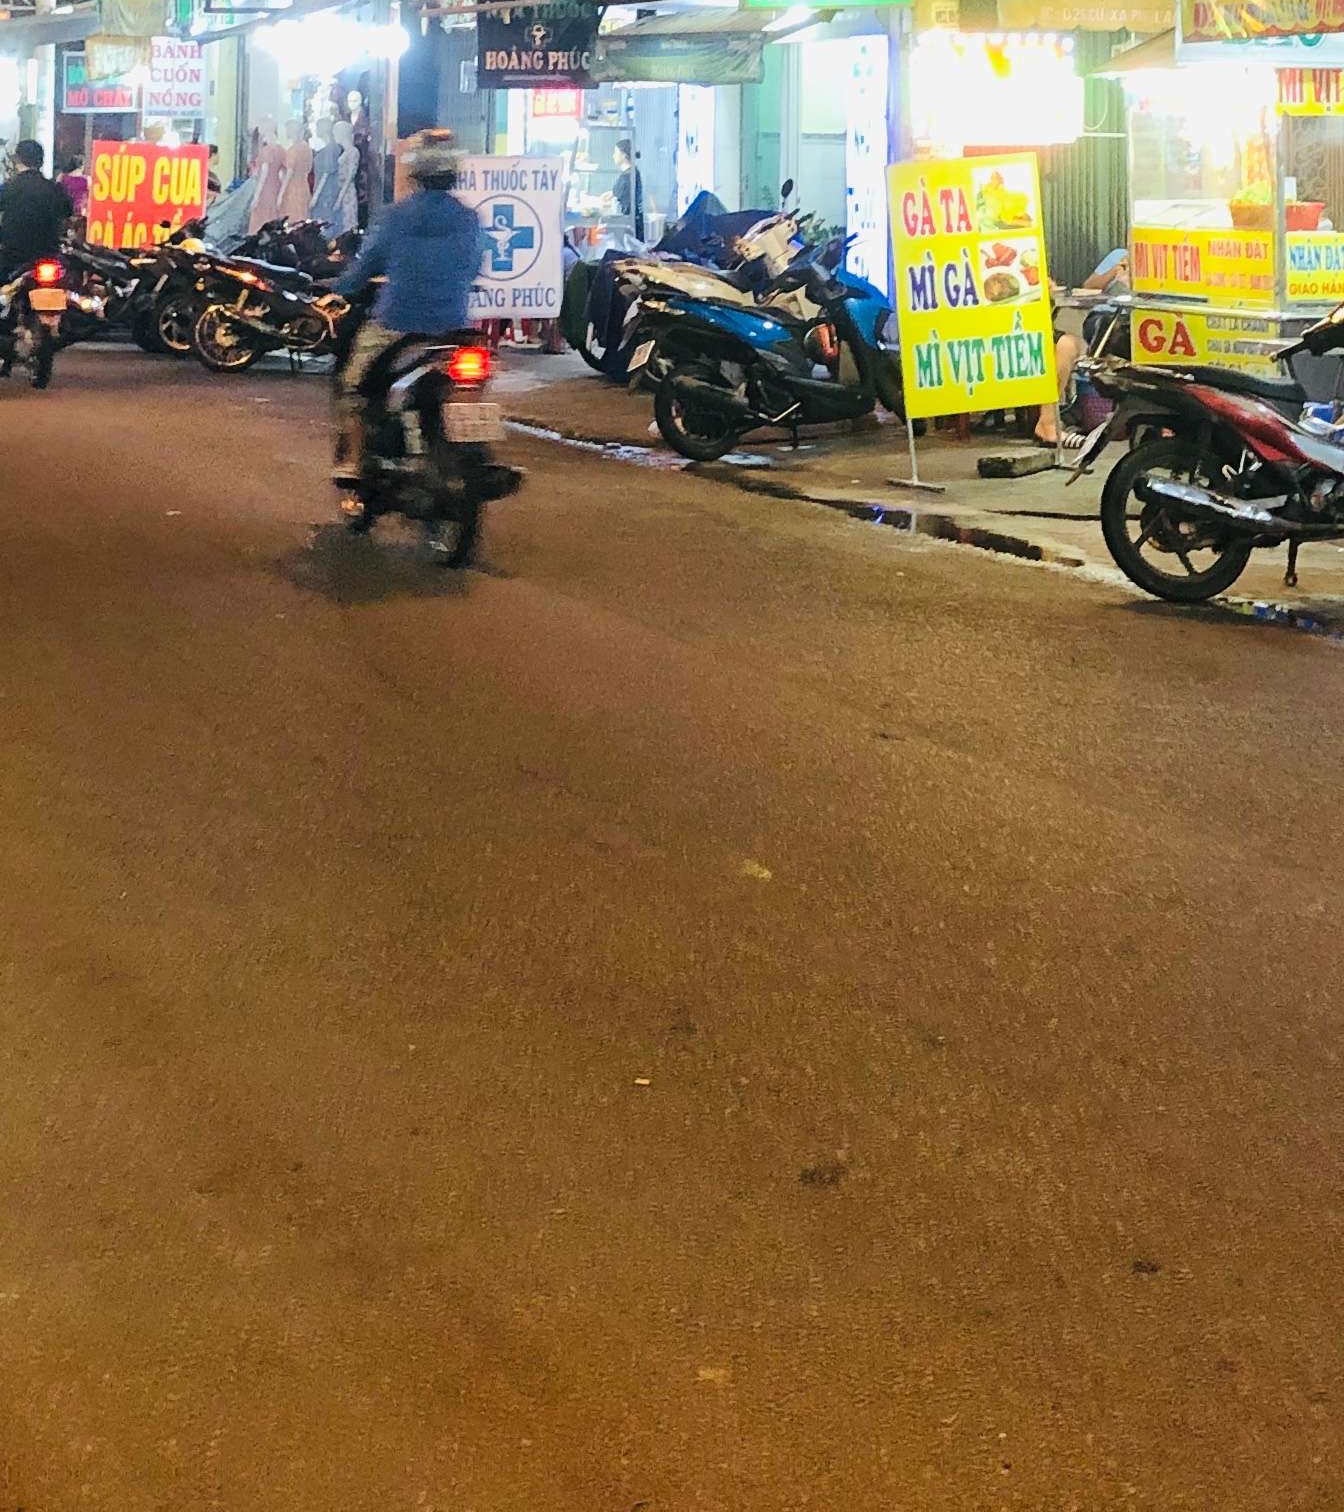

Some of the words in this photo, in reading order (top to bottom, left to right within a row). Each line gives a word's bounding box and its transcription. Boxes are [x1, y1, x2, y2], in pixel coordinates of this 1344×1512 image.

[150, 62, 202, 83] CUỐN
[485, 45, 545, 70] HOÀNG
[547, 46, 591, 71] PHÚC
[93, 144, 147, 203] SÚP
[152, 156, 202, 206] CUA
[454, 163, 477, 191] HÀ
[482, 159, 528, 191] THUỐC
[531, 163, 559, 191] TÂY
[902, 178, 936, 236] GÀ
[940, 187, 972, 233] TA
[511, 283, 556, 307] PHÚC
[909, 251, 938, 311] MÌ
[944, 248, 979, 306] GÀ
[1289, 283, 1318, 295] GIAO
[1138, 311, 1197, 357] GÀ
[916, 329, 943, 387] MÌ
[947, 338, 985, 396] VỊT
